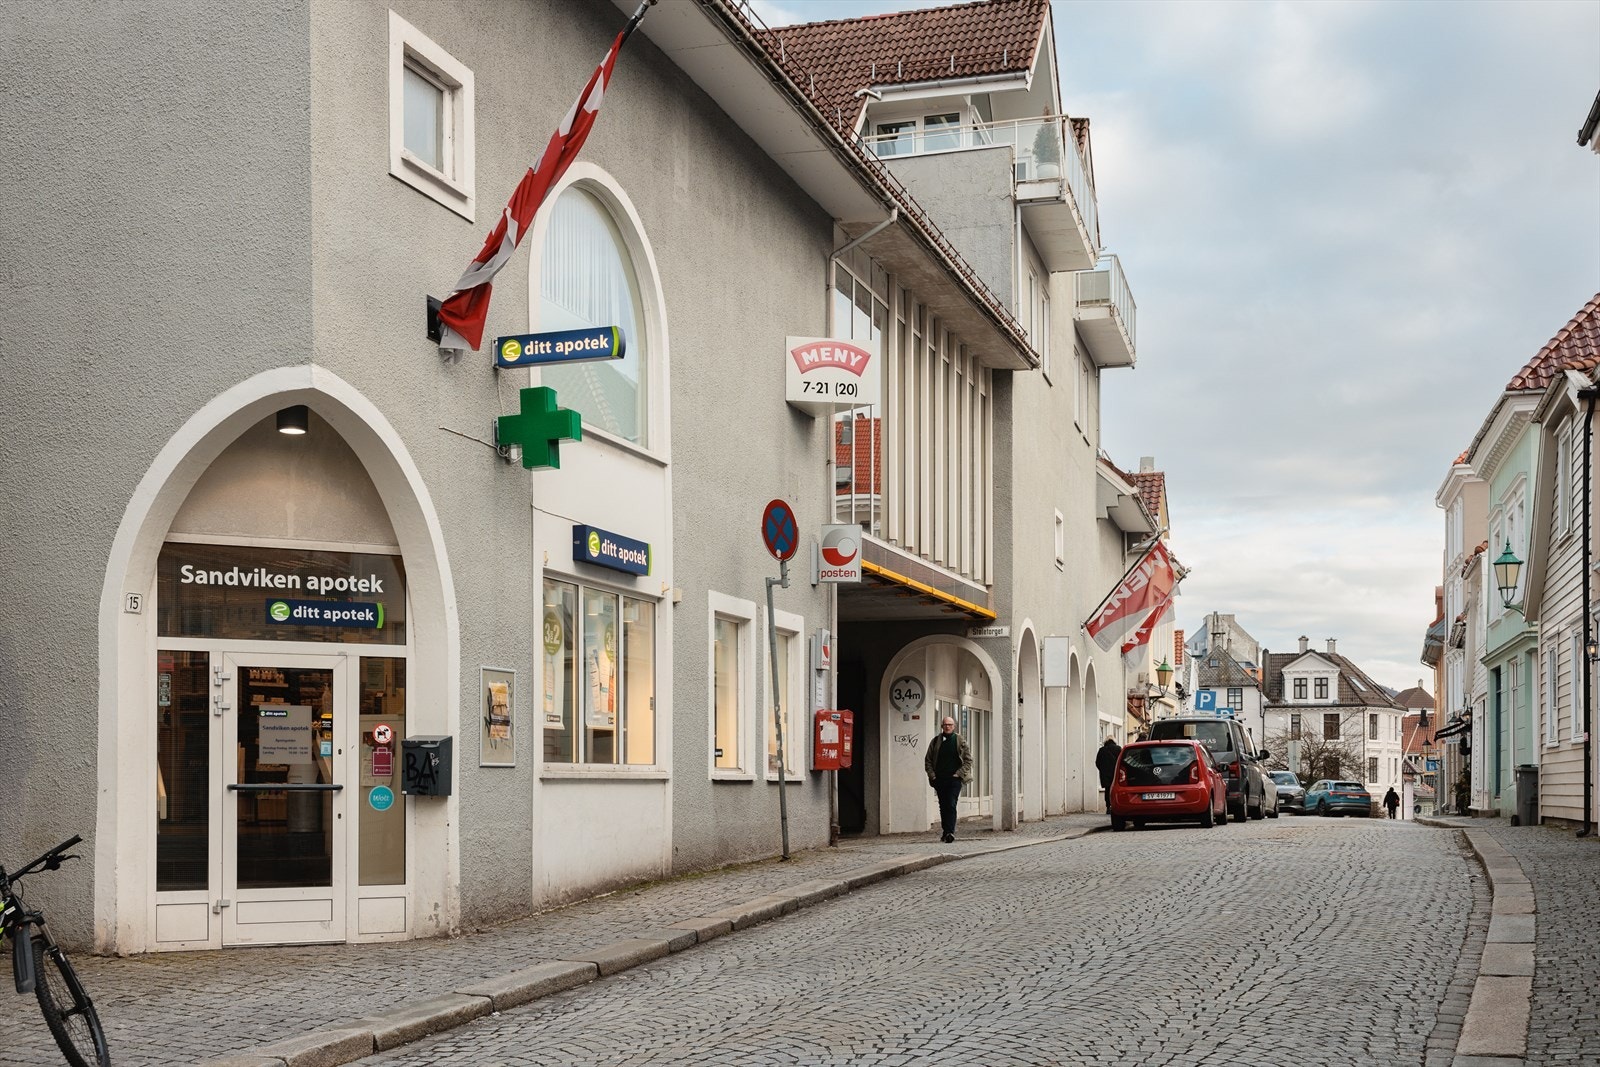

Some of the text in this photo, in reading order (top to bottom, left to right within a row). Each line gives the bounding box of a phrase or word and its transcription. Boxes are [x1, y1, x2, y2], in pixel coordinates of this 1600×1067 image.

[524, 334, 609, 355] ditt apotek
[801, 347, 863, 367] MENY
[803, 381, 858, 398] 7-21 (20)
[601, 538, 647, 566] ditt apotek
[180, 564, 384, 595] Sandviken apotek
[820, 568, 857, 580] posten
[129, 596, 139, 610] 15
[293, 606, 374, 622] ditt apotek
[1200, 692, 1212, 708] P
